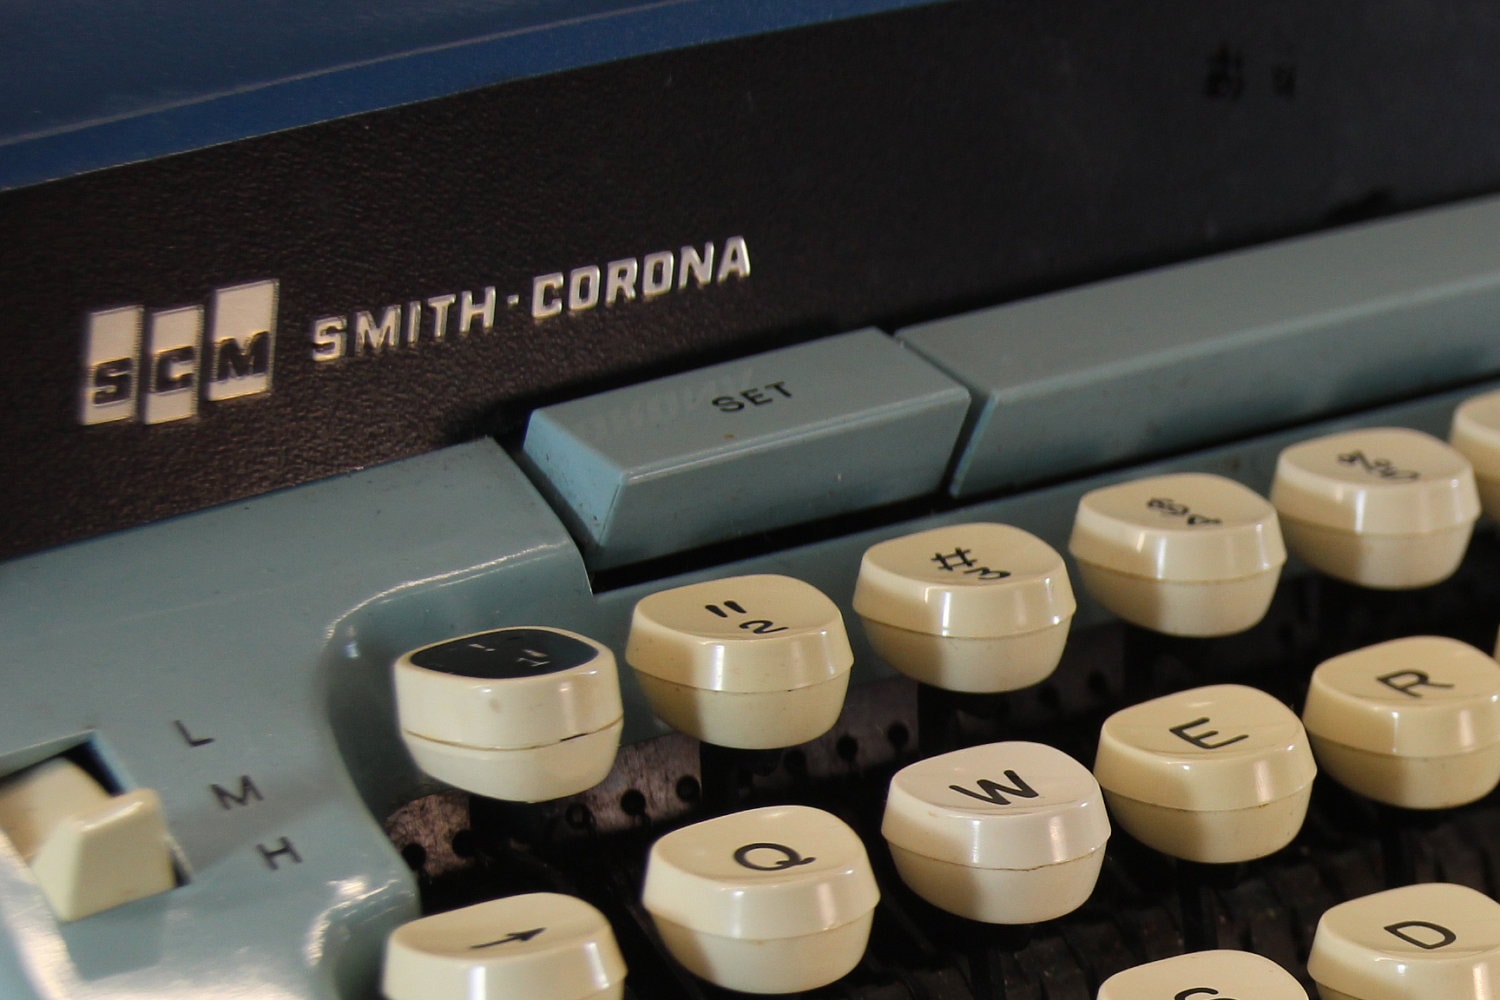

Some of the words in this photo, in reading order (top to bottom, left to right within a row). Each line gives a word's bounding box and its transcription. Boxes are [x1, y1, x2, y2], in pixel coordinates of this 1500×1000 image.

[88, 320, 274, 412] SCM
[711, 380, 793, 413] SET
[1375, 668, 1455, 699] R
[174, 718, 214, 748] L
[1168, 716, 1250, 750] E
[210, 774, 264, 811] M
[948, 769, 1040, 806] W
[256, 835, 303, 871] H
[732, 842, 816, 872] Q
[1383, 920, 1457, 951] D
